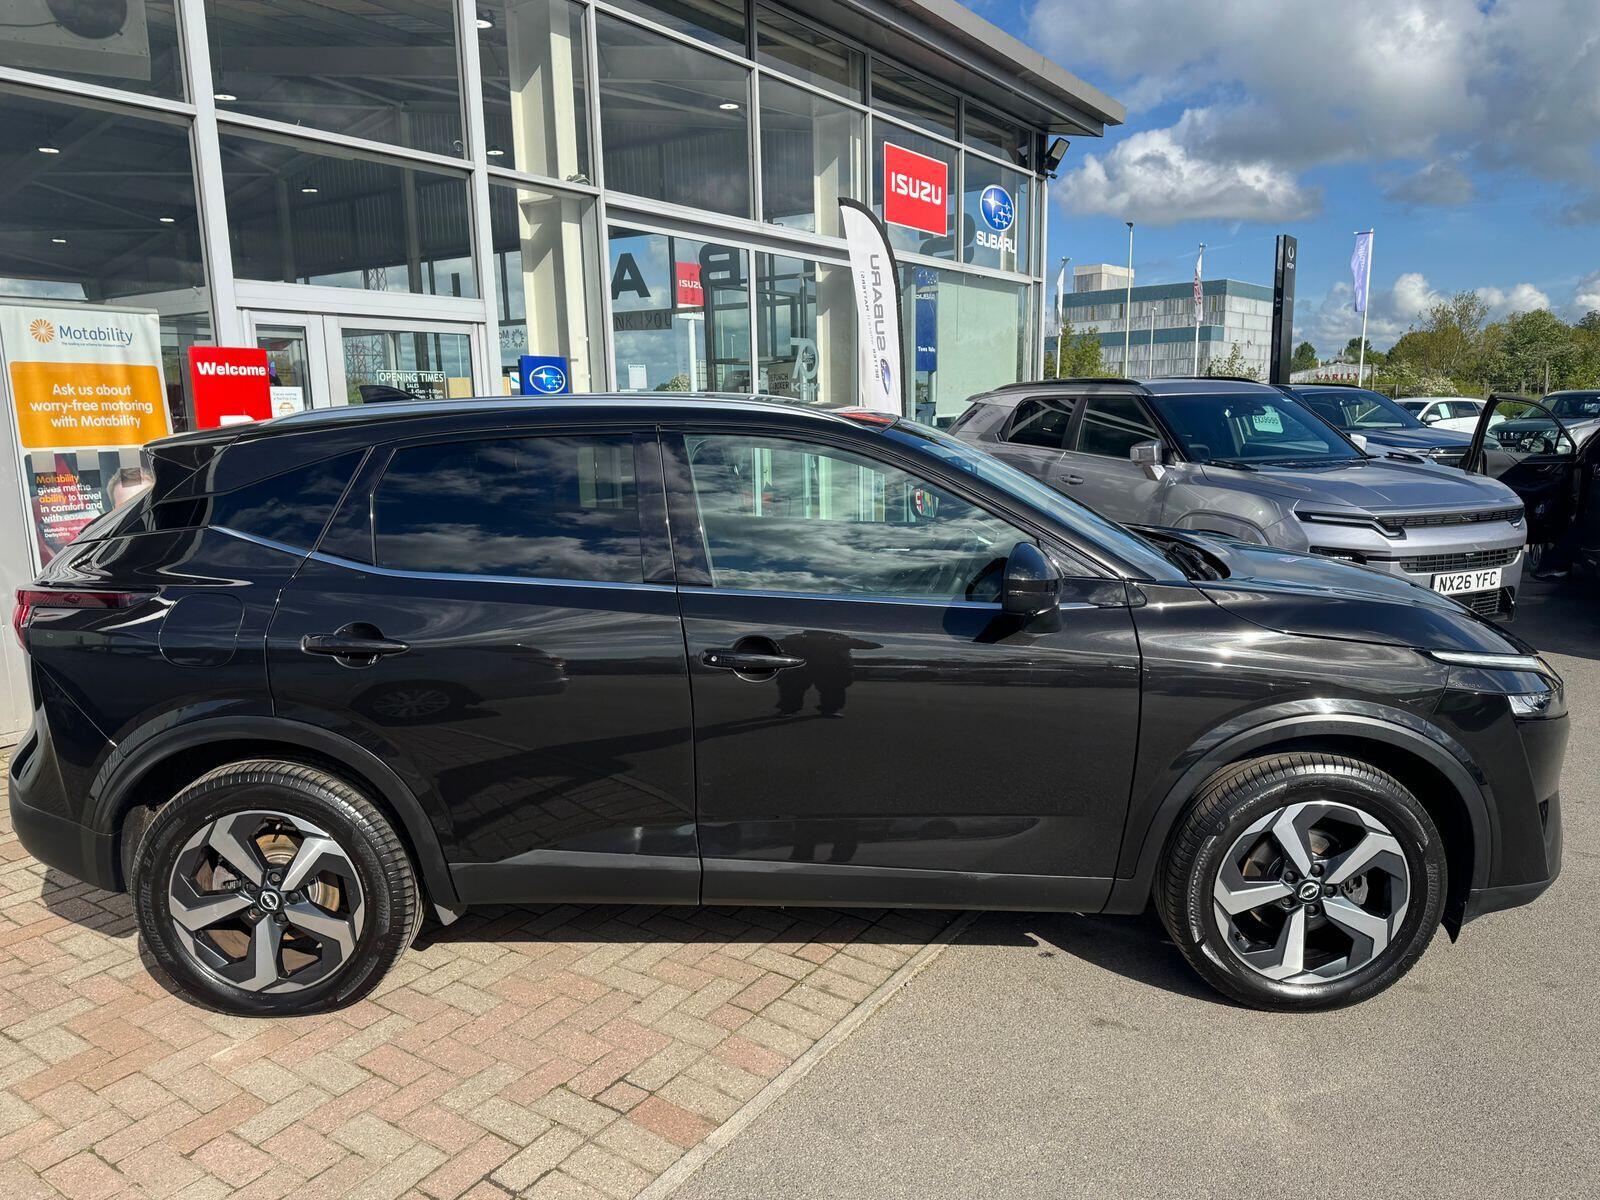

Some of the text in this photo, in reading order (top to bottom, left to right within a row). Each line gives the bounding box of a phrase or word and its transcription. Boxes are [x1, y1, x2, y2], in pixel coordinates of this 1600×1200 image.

[891, 171, 942, 206] ISUZU
[976, 230, 1016, 254] SUBARU
[59, 325, 133, 346] Motability
[196, 361, 267, 376] Welcome
[379, 372, 444, 383] OPENING TIMES
[1315, 372, 1359, 382] VARLEY
[52, 383, 131, 396] Ask us about
[29, 399, 153, 414] worry-free motoring
[50, 414, 141, 429] with Motability
[36, 473, 80, 485] Motability
[37, 485, 62, 496] gives
[77, 483, 92, 492] the
[38, 491, 102, 504] ability to travel
[40, 500, 103, 513] in comfort and
[41, 513, 62, 524] with
[1438, 571, 1497, 592] NX26 YFC
